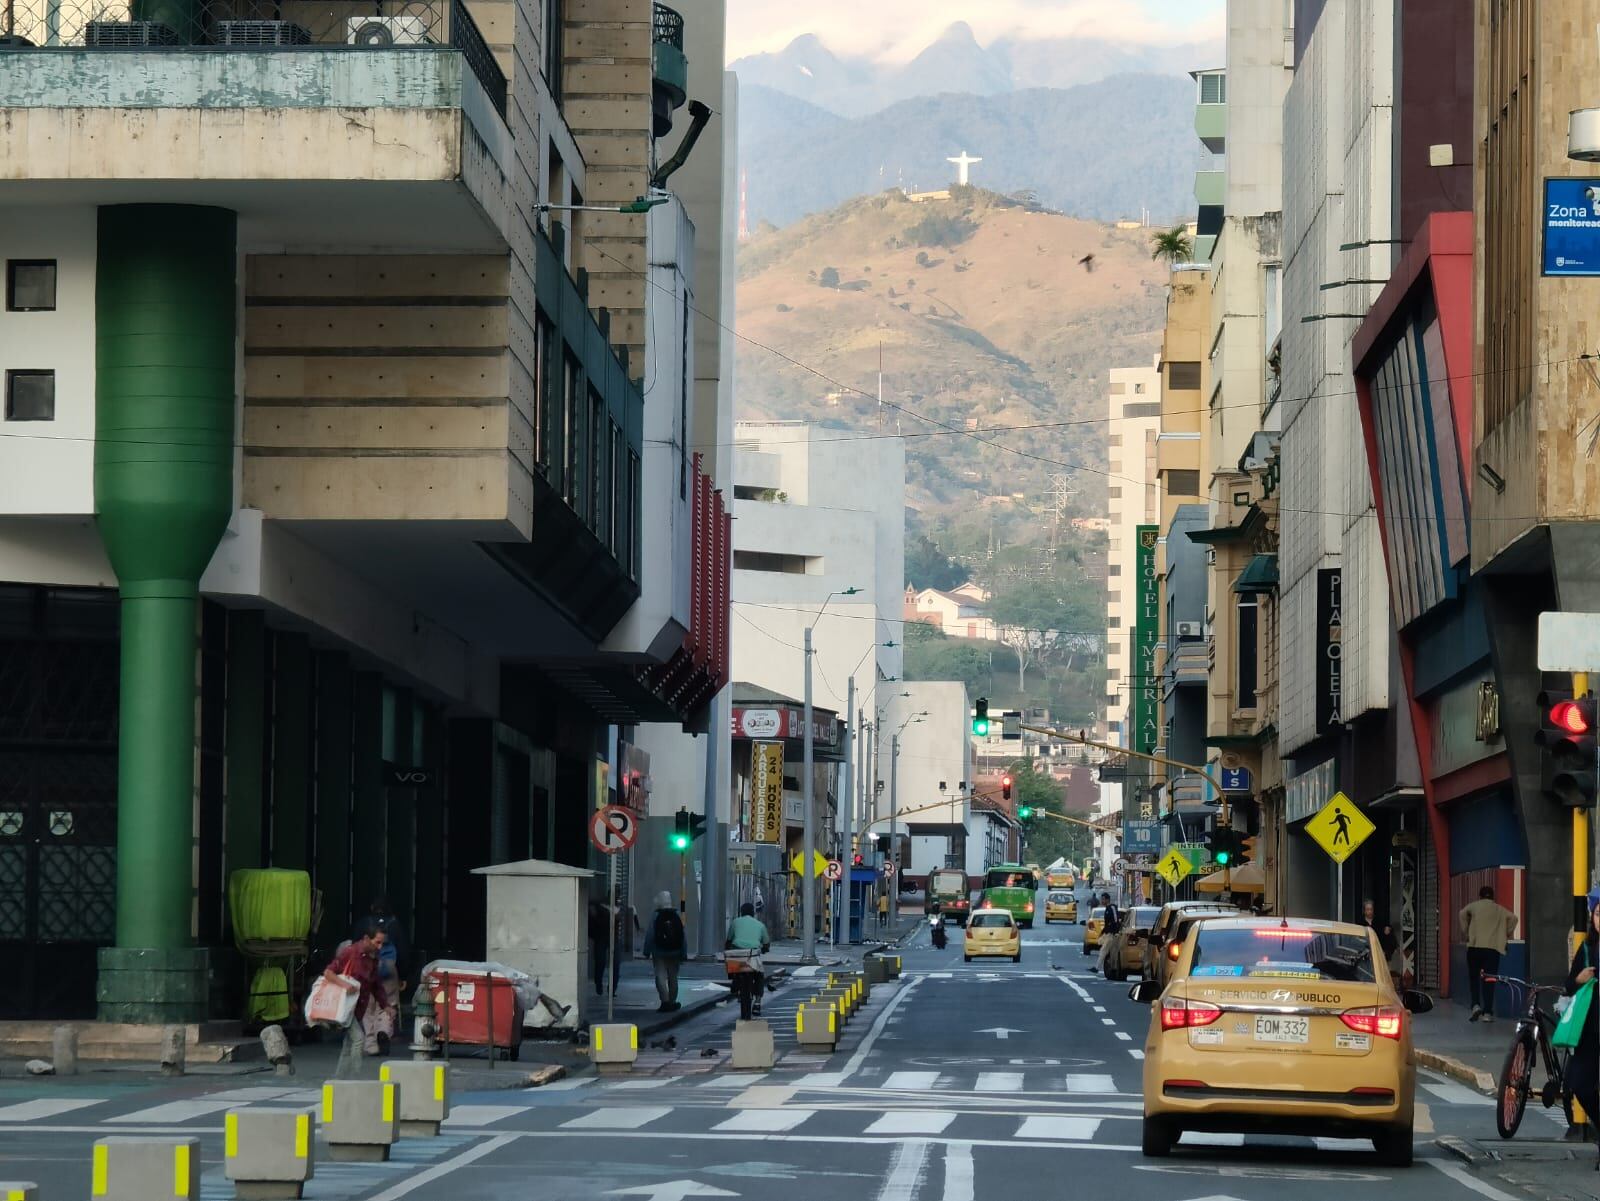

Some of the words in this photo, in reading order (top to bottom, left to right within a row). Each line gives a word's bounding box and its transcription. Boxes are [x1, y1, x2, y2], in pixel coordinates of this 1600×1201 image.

[1549, 204, 1587, 218] Zona
[1143, 555, 1157, 618] HOTEL
[1326, 575, 1342, 725] PLAZOLETA
[1142, 630, 1158, 744] IMPERIAL
[769, 756, 777, 776] 24
[755, 743, 769, 842] PARQUEADERO
[767, 784, 778, 831] HORAS
[1133, 829, 1151, 842] 10
[1220, 990, 1267, 1001] SERVICIO
[1295, 993, 1341, 1004] PUBLICO
[1282, 1020, 1307, 1036] 332
